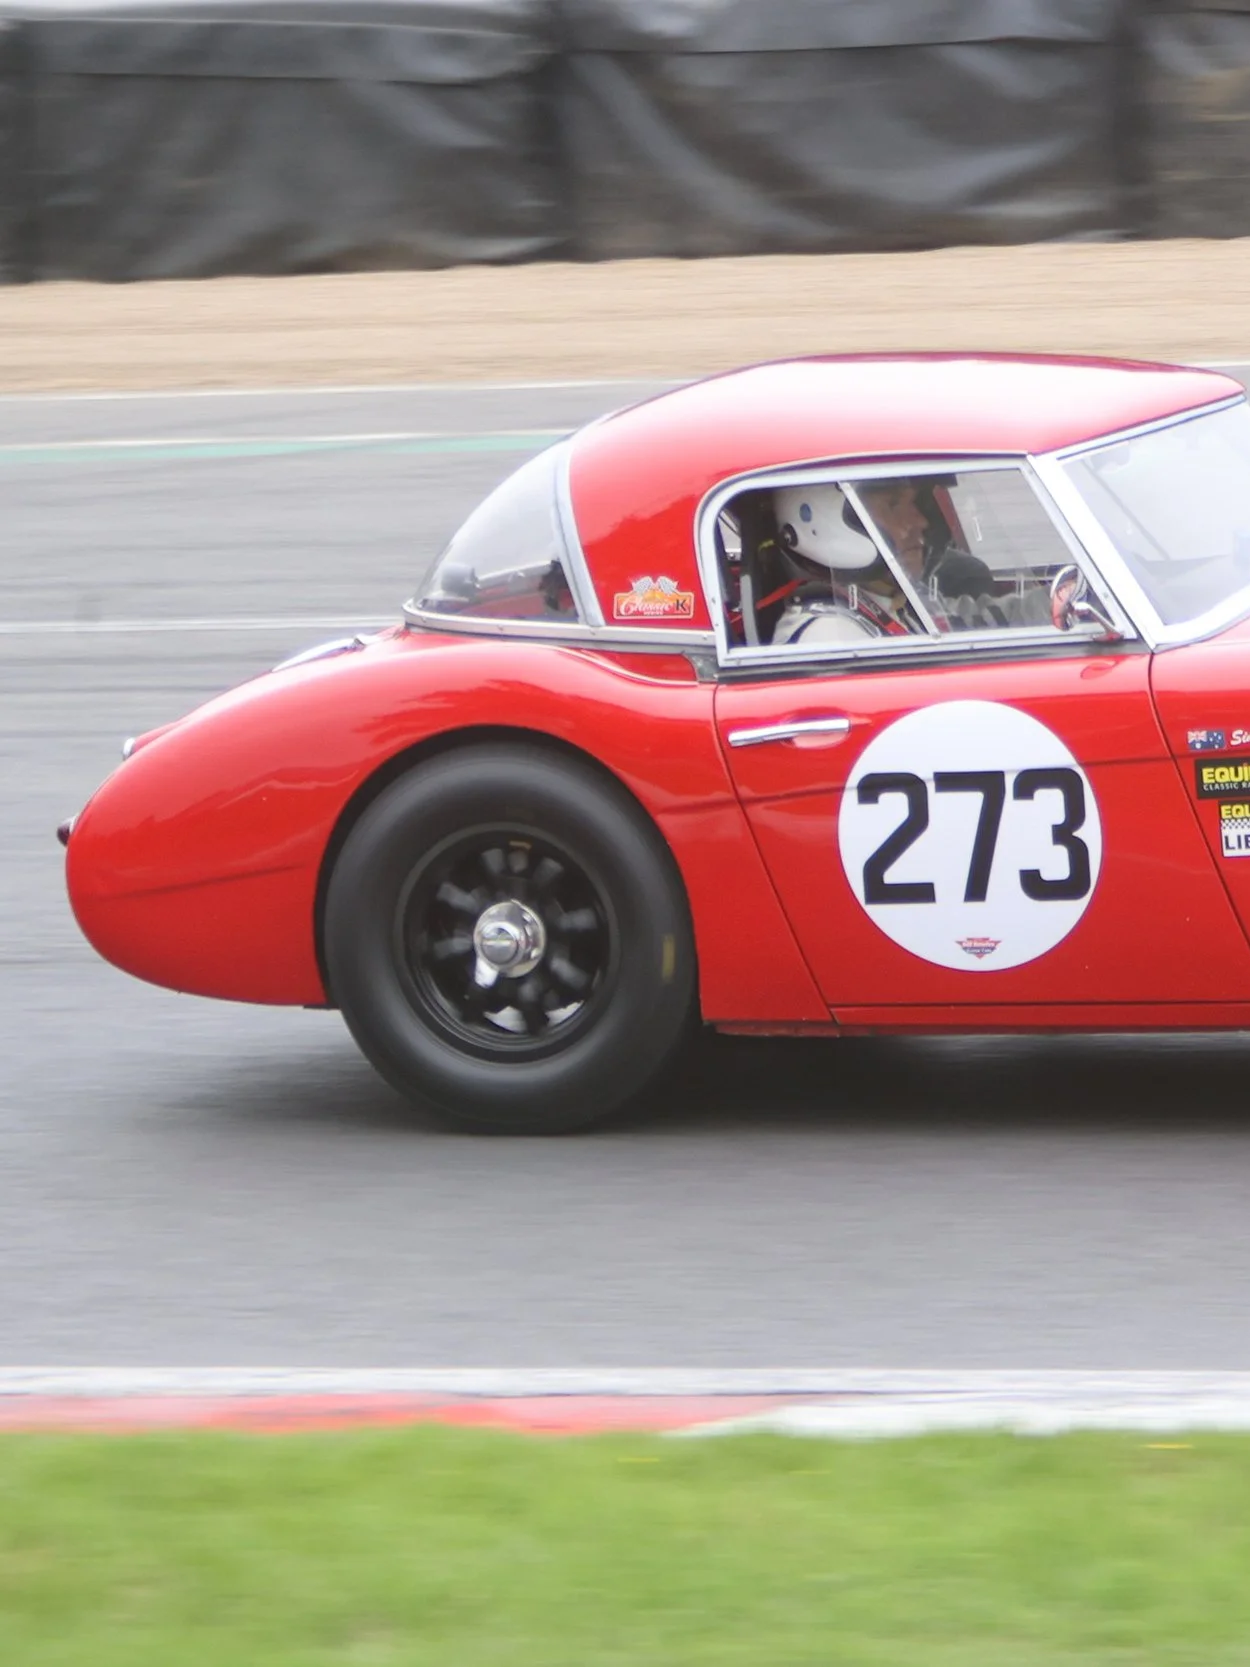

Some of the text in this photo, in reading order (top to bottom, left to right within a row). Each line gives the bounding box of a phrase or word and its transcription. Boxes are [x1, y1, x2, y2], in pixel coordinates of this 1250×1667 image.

[676, 599, 688, 612] K
[1203, 783, 1239, 791] CLASSIC
[857, 767, 1091, 905] 273
